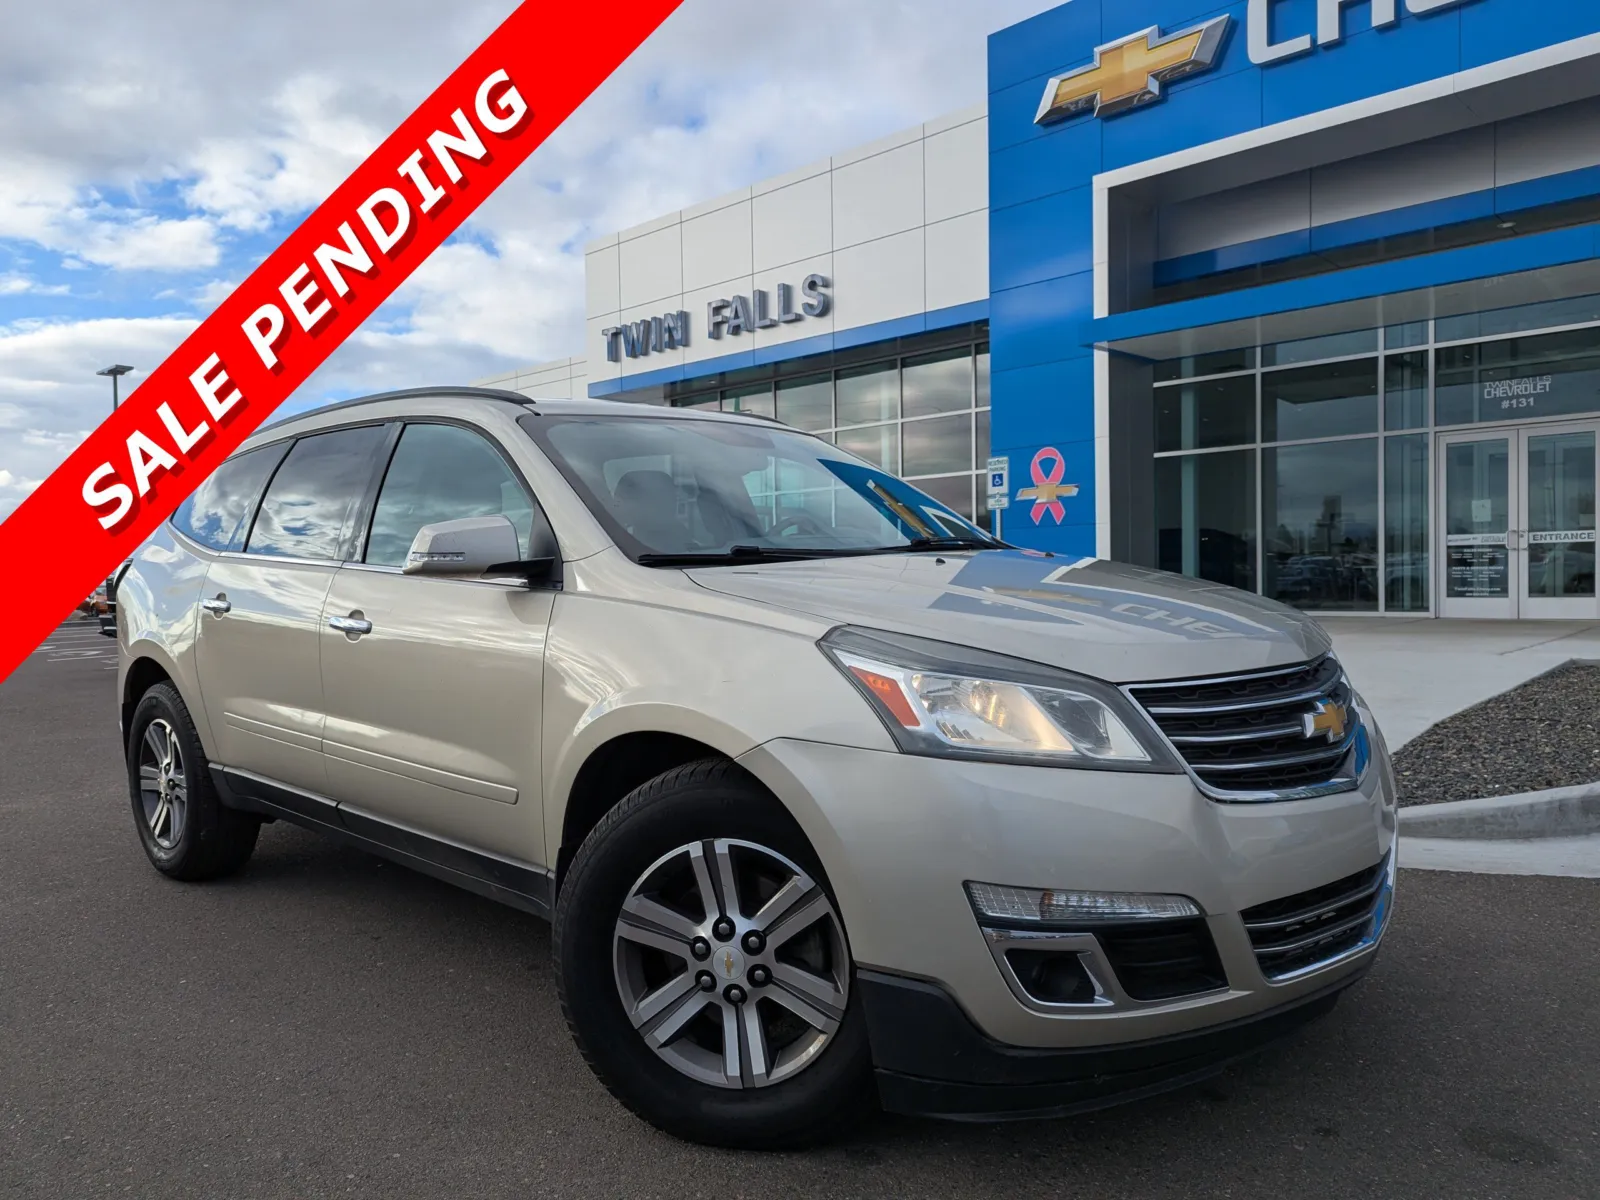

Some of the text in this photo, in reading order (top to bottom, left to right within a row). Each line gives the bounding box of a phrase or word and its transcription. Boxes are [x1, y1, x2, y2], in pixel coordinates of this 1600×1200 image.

[602, 274, 832, 362] TWIN FALLS
[1484, 381, 1552, 399] CHEVROLET
[1501, 397, 1535, 409] #131
[1532, 532, 1595, 541] ENTRANCE
